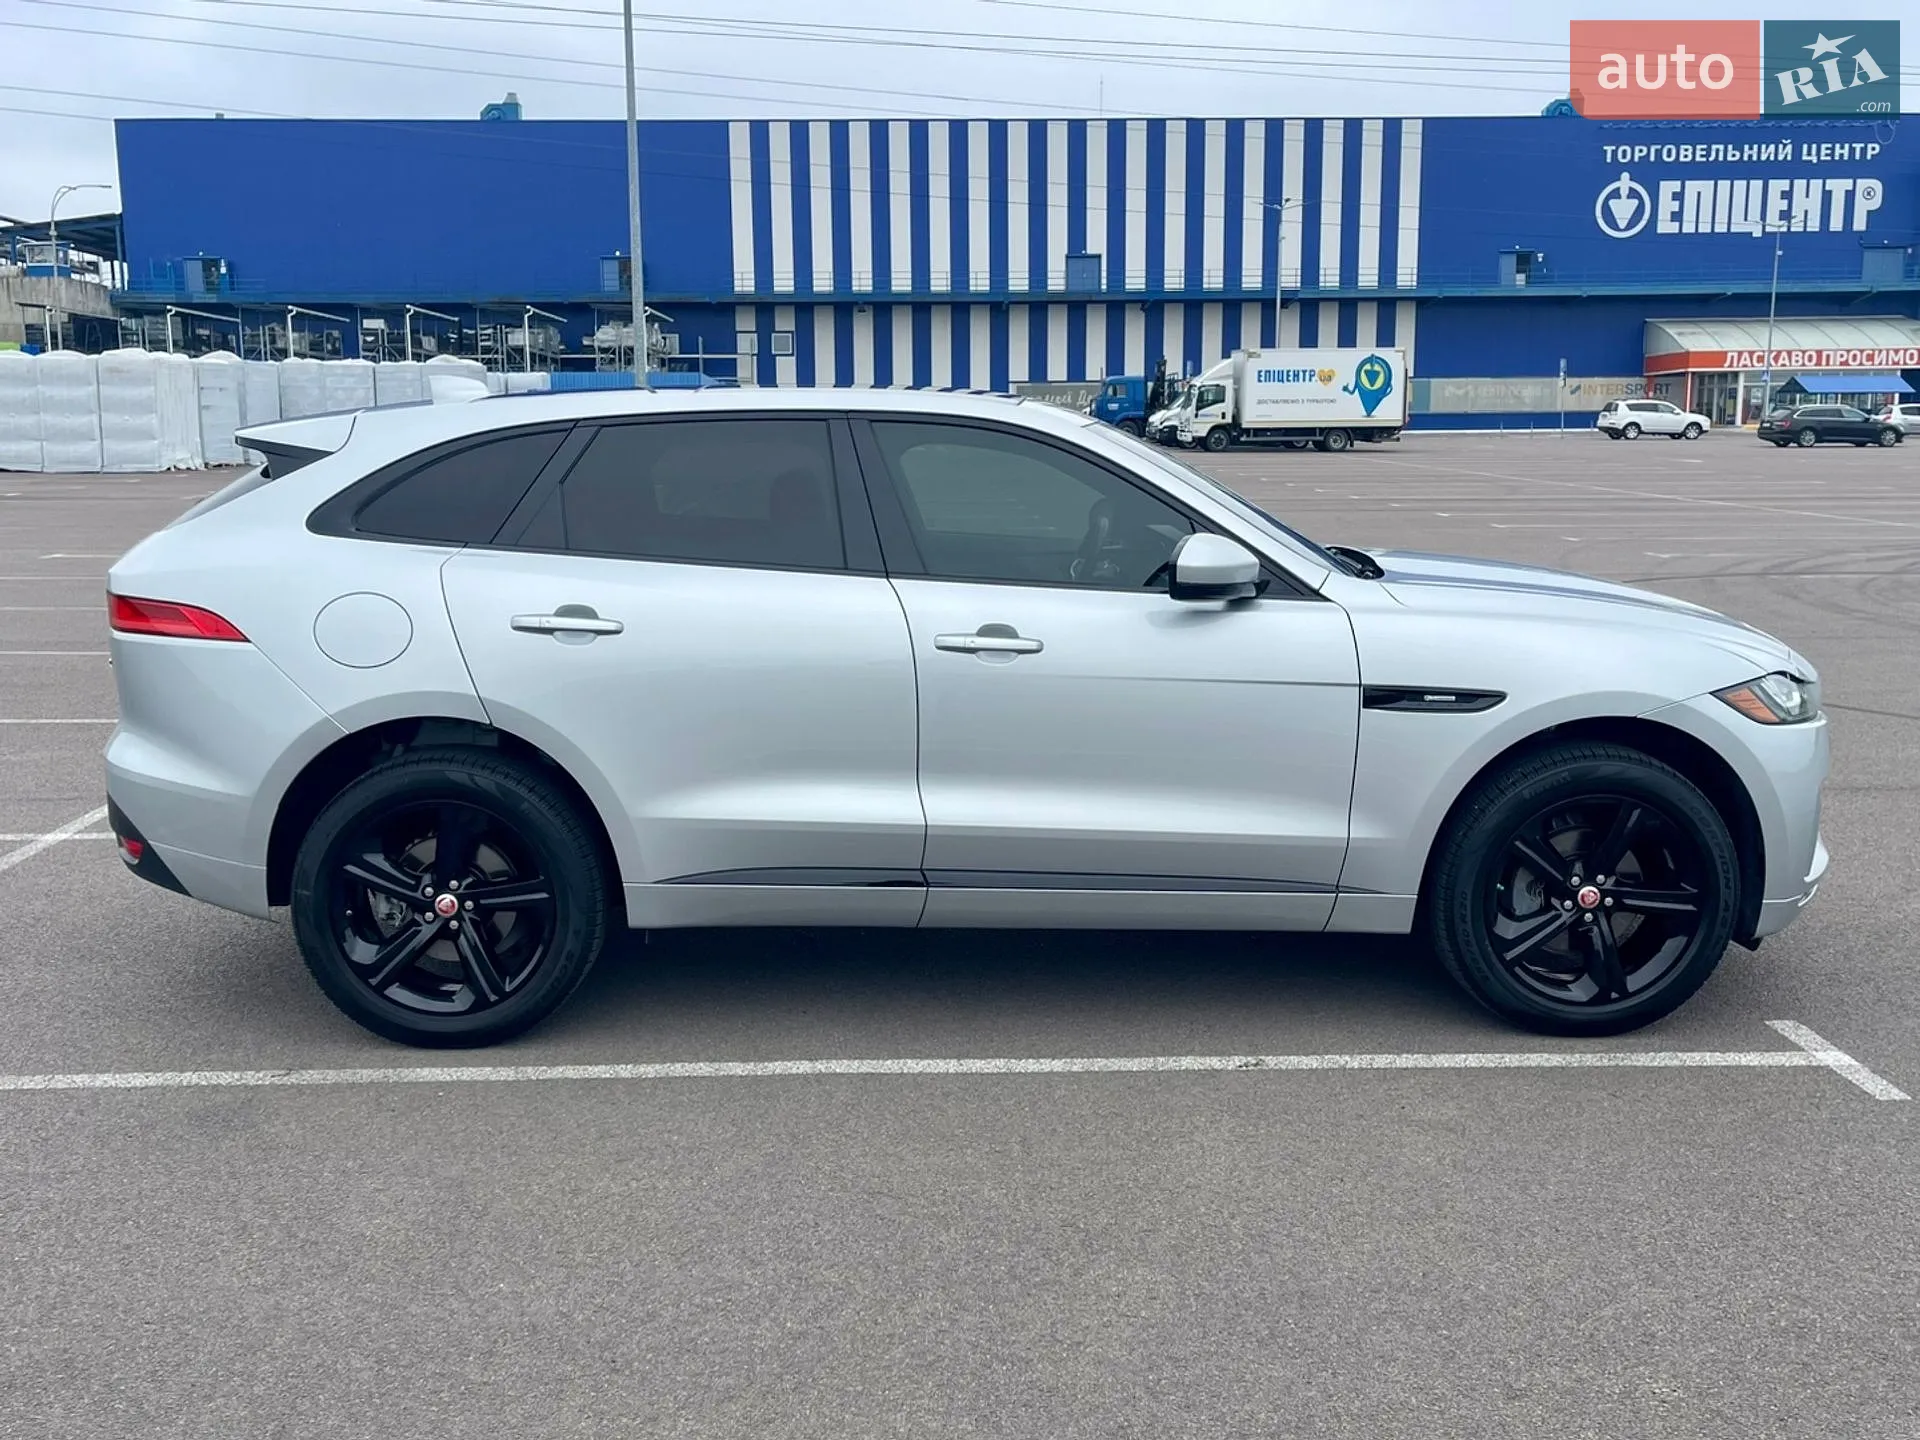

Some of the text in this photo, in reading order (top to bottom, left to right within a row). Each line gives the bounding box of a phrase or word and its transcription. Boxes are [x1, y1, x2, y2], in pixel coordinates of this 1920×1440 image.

[1603, 140, 1881, 164] ТОРГОВЕЛЬНИЙ ЦЕНТР
[1723, 349, 1919, 368] ЛАСКАВО ПРОСИМО
